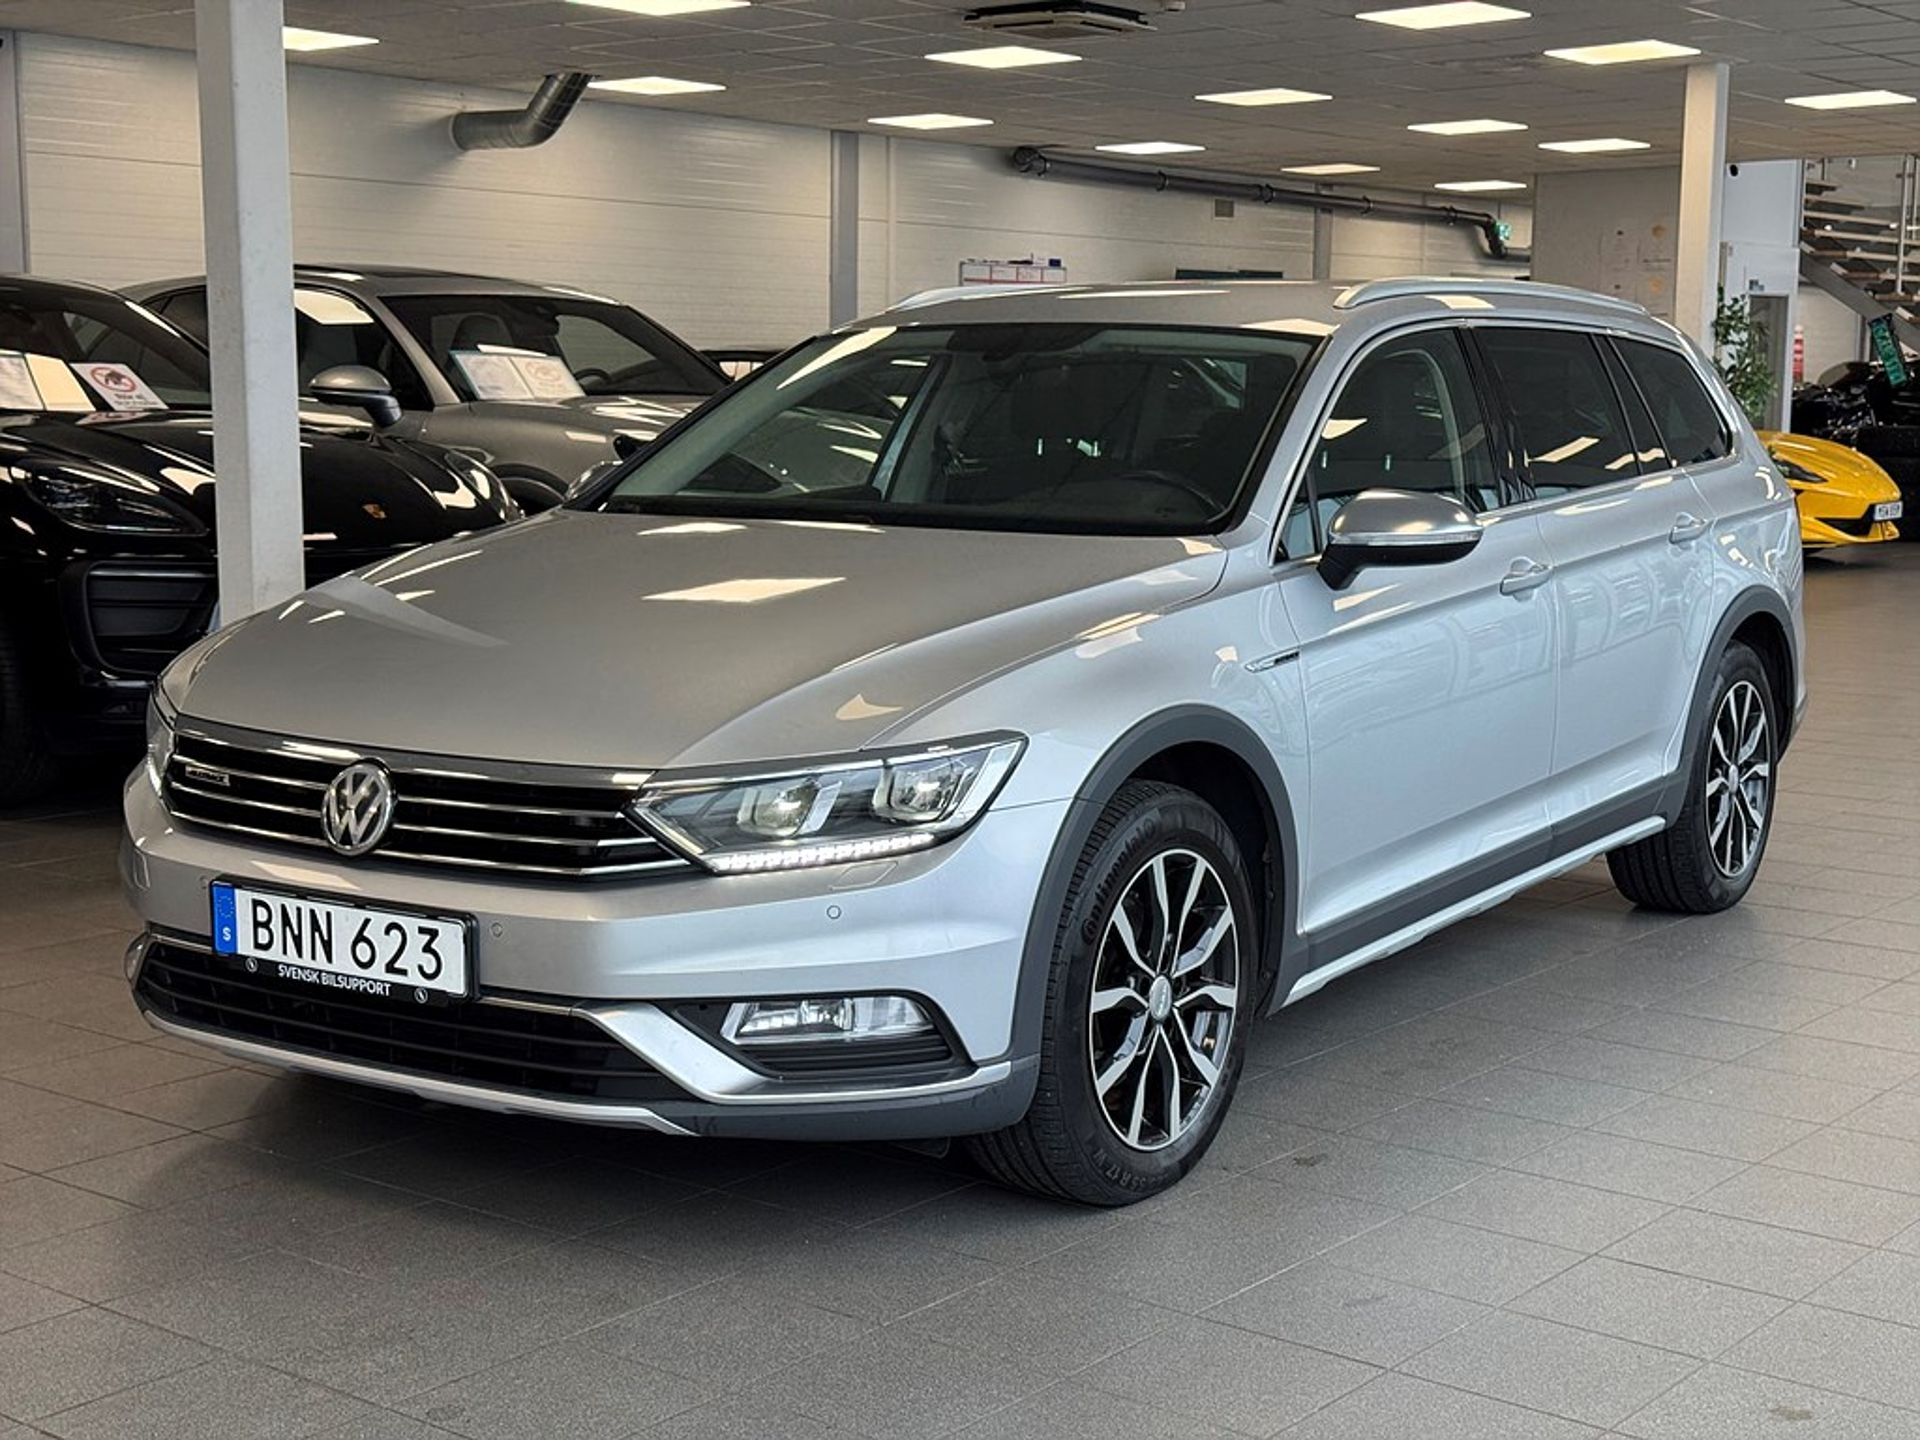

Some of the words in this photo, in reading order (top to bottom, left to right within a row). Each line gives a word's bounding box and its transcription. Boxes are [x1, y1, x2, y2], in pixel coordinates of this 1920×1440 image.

[223, 926, 232, 942] S
[251, 898, 333, 964] BNN
[351, 917, 443, 981] 623
[278, 964, 320, 984] SVENSK
[321, 972, 392, 996] BILSUPPORT
